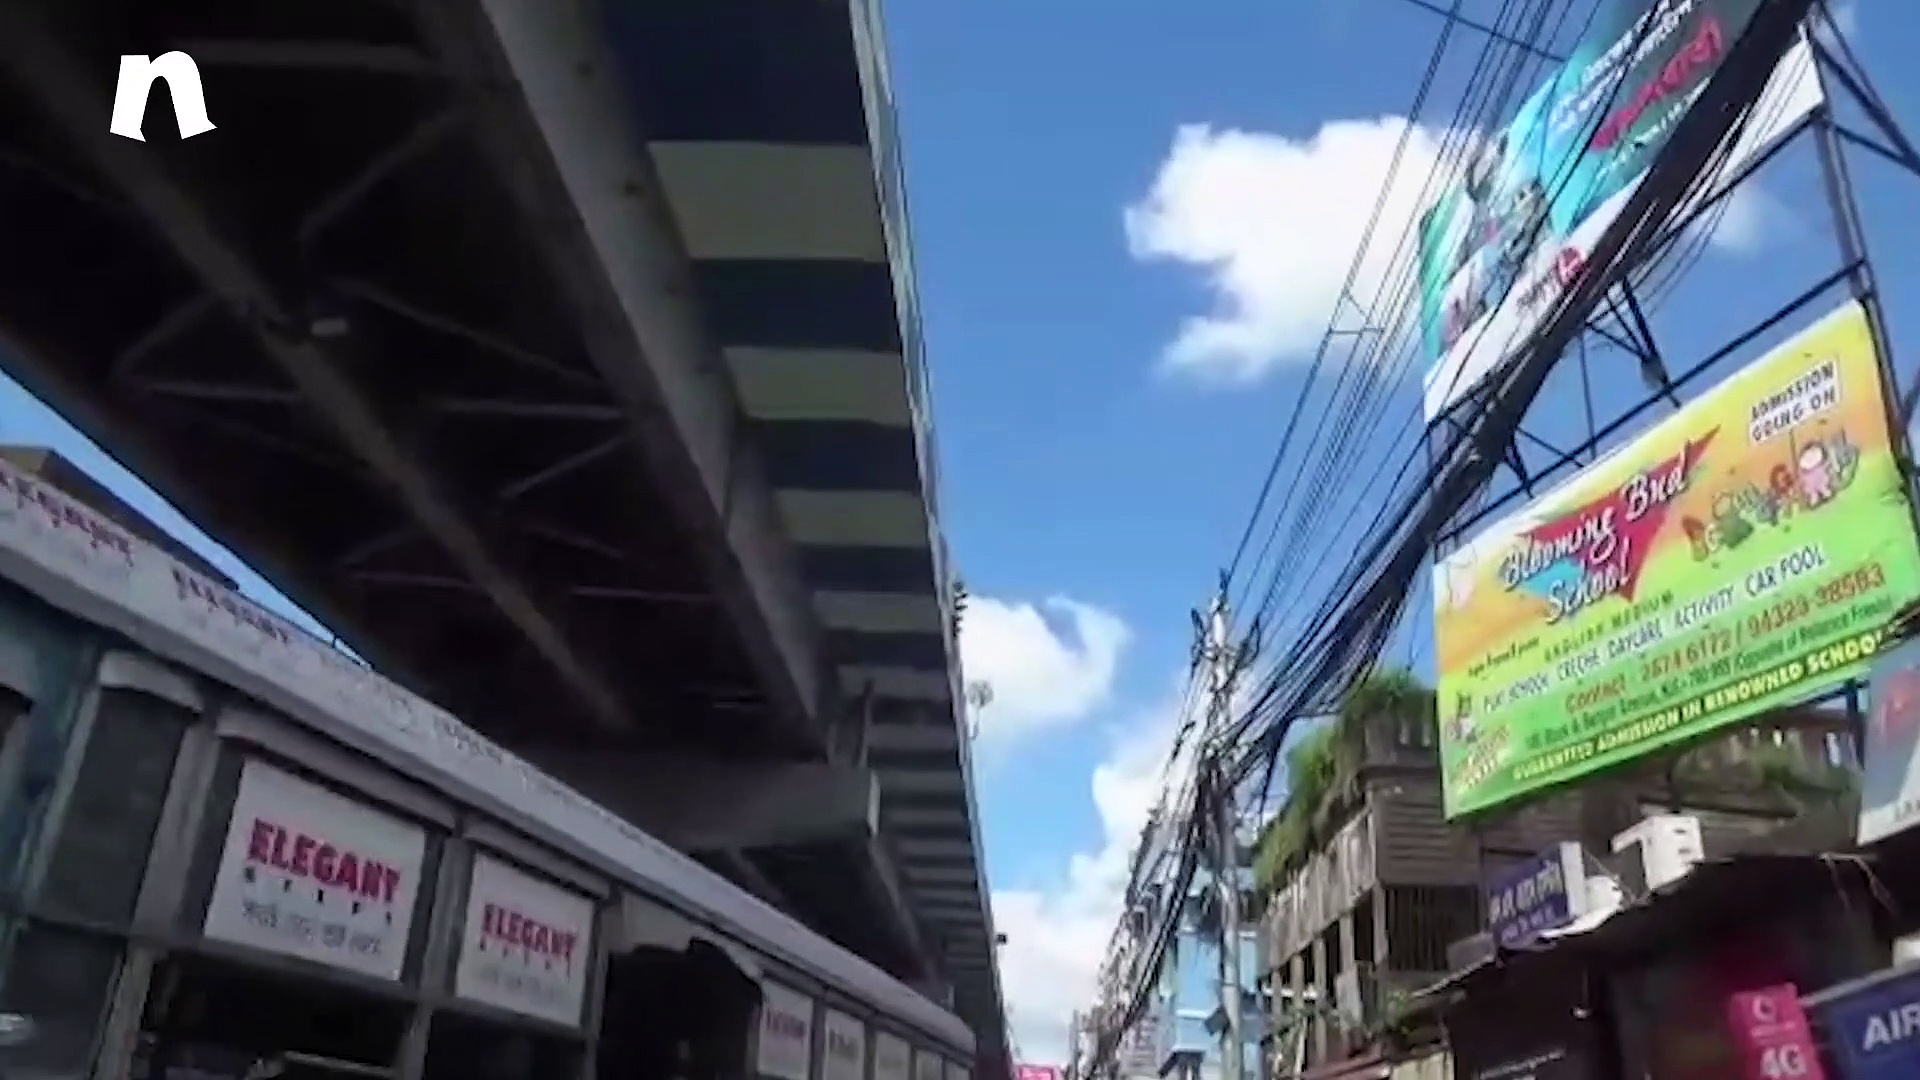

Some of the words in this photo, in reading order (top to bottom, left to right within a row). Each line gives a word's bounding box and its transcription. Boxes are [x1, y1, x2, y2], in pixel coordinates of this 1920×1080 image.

[1751, 361, 1833, 420] ADMISSION
[1752, 402, 1804, 441] GOING
[1810, 386, 1835, 411] ON
[1544, 534, 1632, 624] School
[1675, 584, 1735, 629] ACTIVITY
[1746, 566, 1777, 598] CAR
[1597, 707, 1680, 751] ADMISSION
[1703, 663, 1804, 708] RENOWNED
[248, 817, 401, 903] ELEGANT
[482, 903, 578, 958] ELEGANT
[1863, 1001, 1920, 1051] AIR
[1761, 1044, 1807, 1077] 4G
